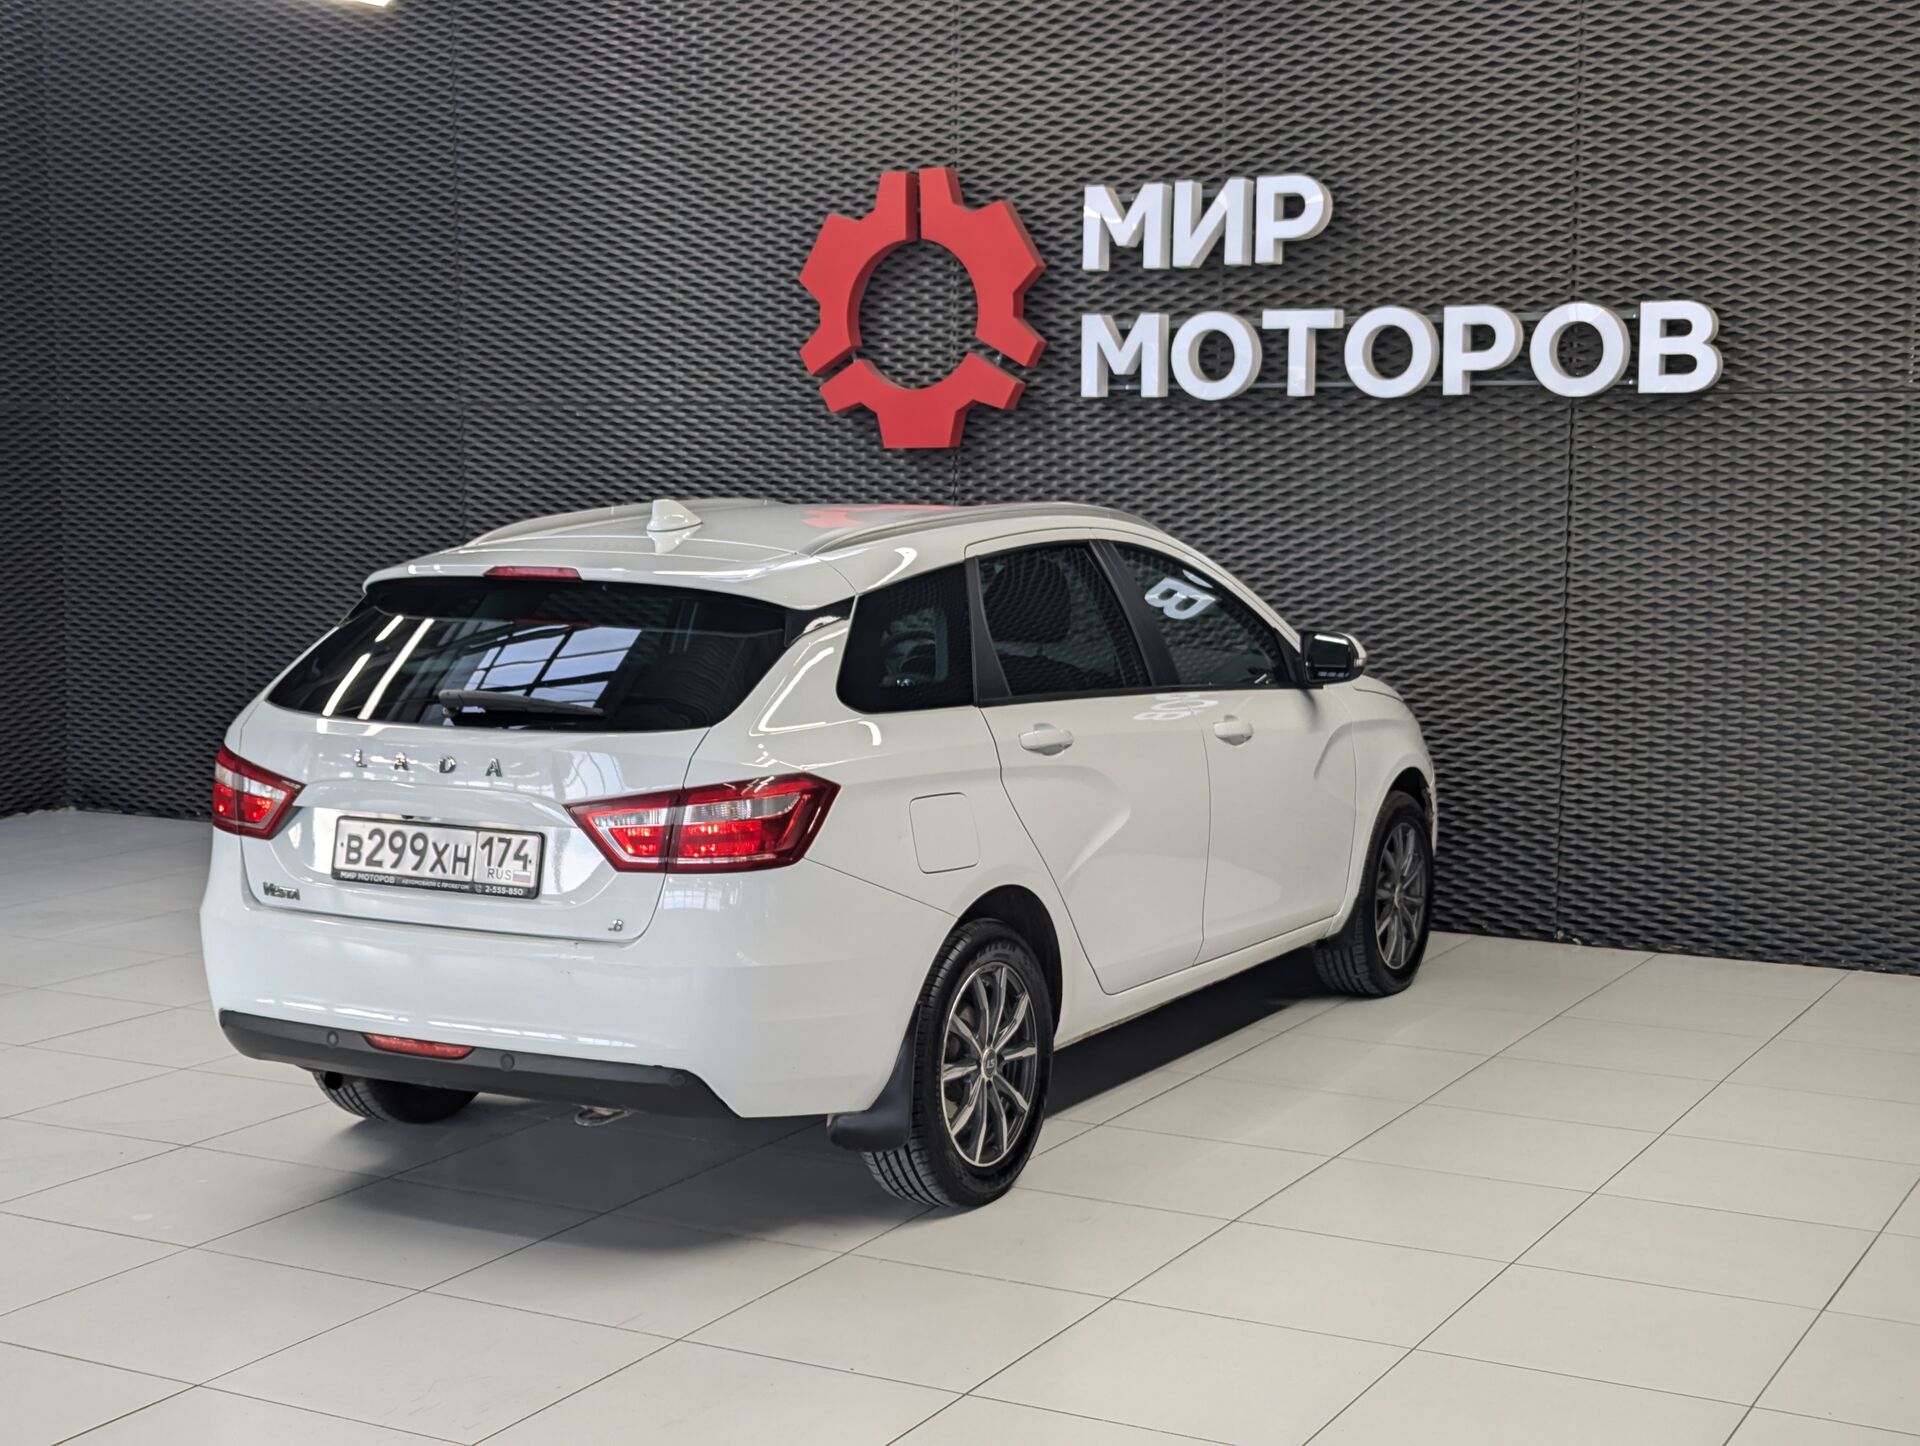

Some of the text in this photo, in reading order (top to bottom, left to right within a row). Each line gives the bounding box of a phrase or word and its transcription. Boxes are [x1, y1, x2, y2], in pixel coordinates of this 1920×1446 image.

[1081, 174, 1332, 271] МИР
[1080, 300, 1723, 401] МОТОРОВ
[353, 748, 503, 778] LADA
[344, 828, 471, 876] В299ХН
[480, 835, 529, 871] 174
[340, 870, 396, 885] МИР МОТОРОВ
[487, 867, 512, 881] RUS
